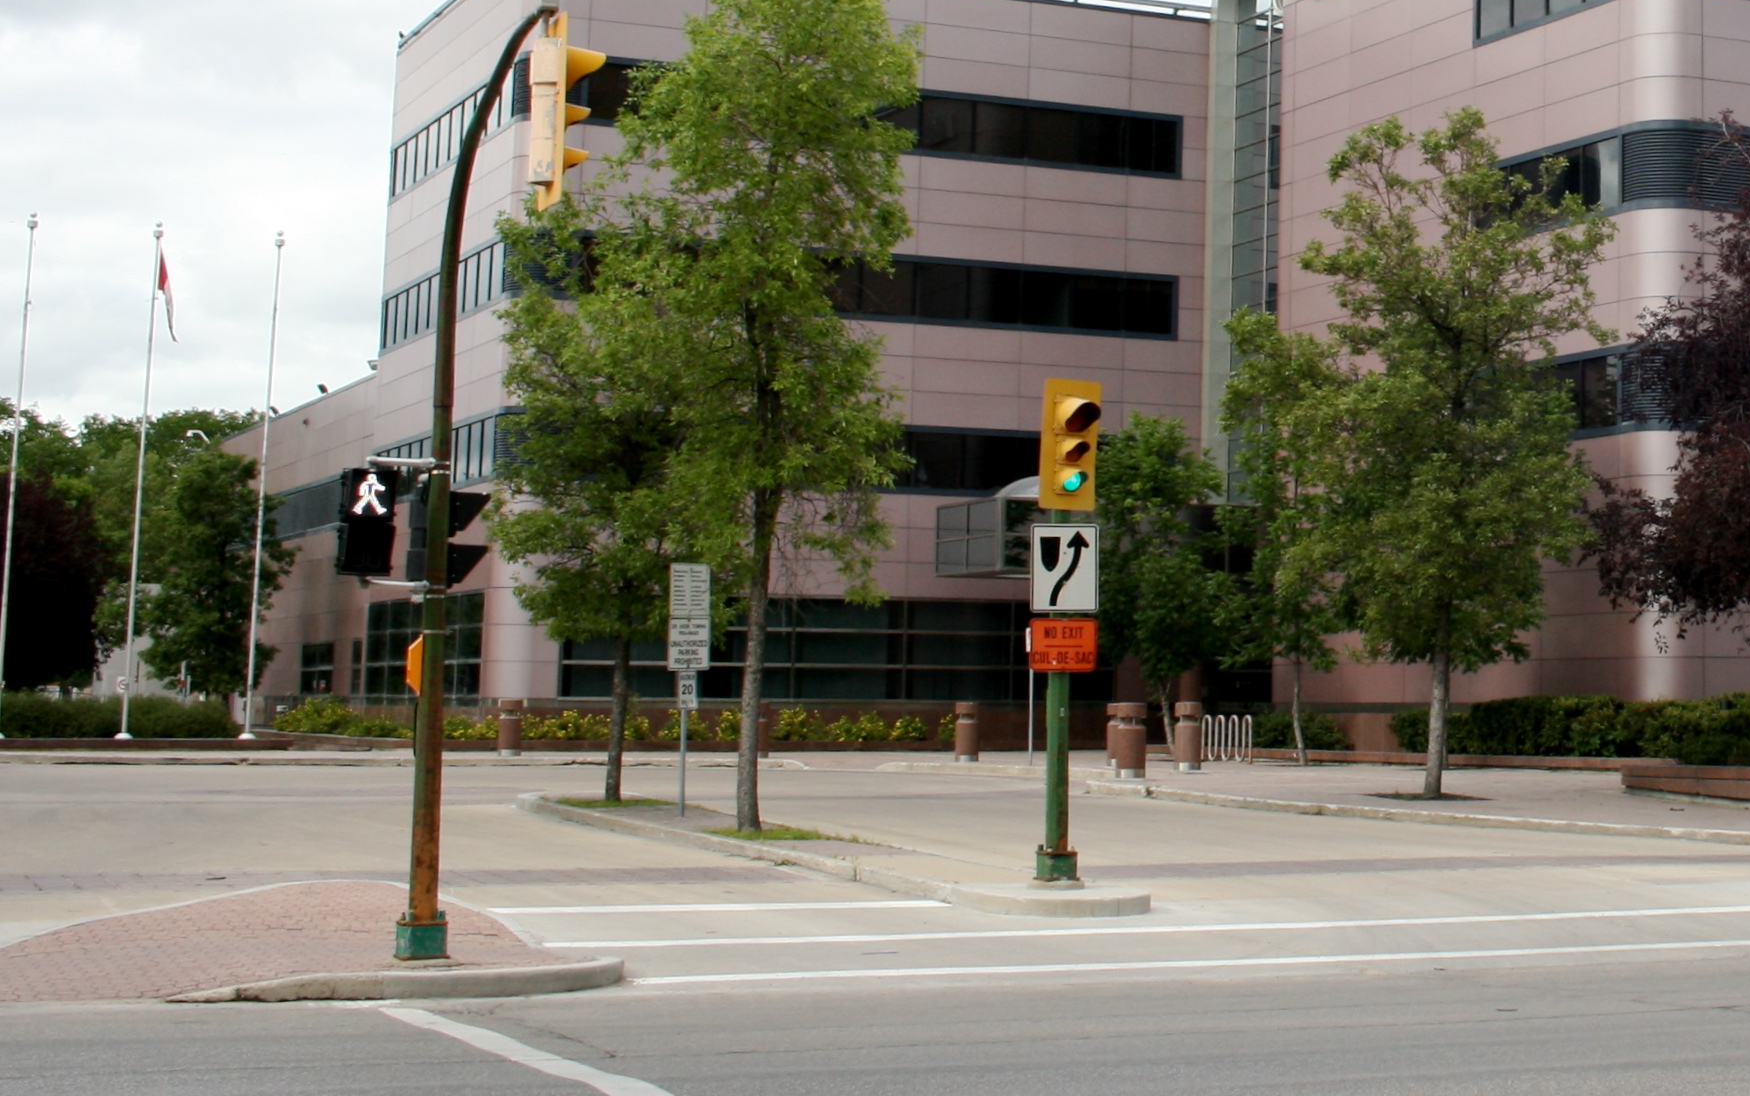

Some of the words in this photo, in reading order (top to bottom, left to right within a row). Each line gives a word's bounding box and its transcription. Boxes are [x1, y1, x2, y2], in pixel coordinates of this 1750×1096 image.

[1044, 627, 1057, 639] NO
[1062, 627, 1084, 639] EXIT
[1032, 652, 1093, 664] CUL-DE-SAC
[681, 684, 693, 695] 20
